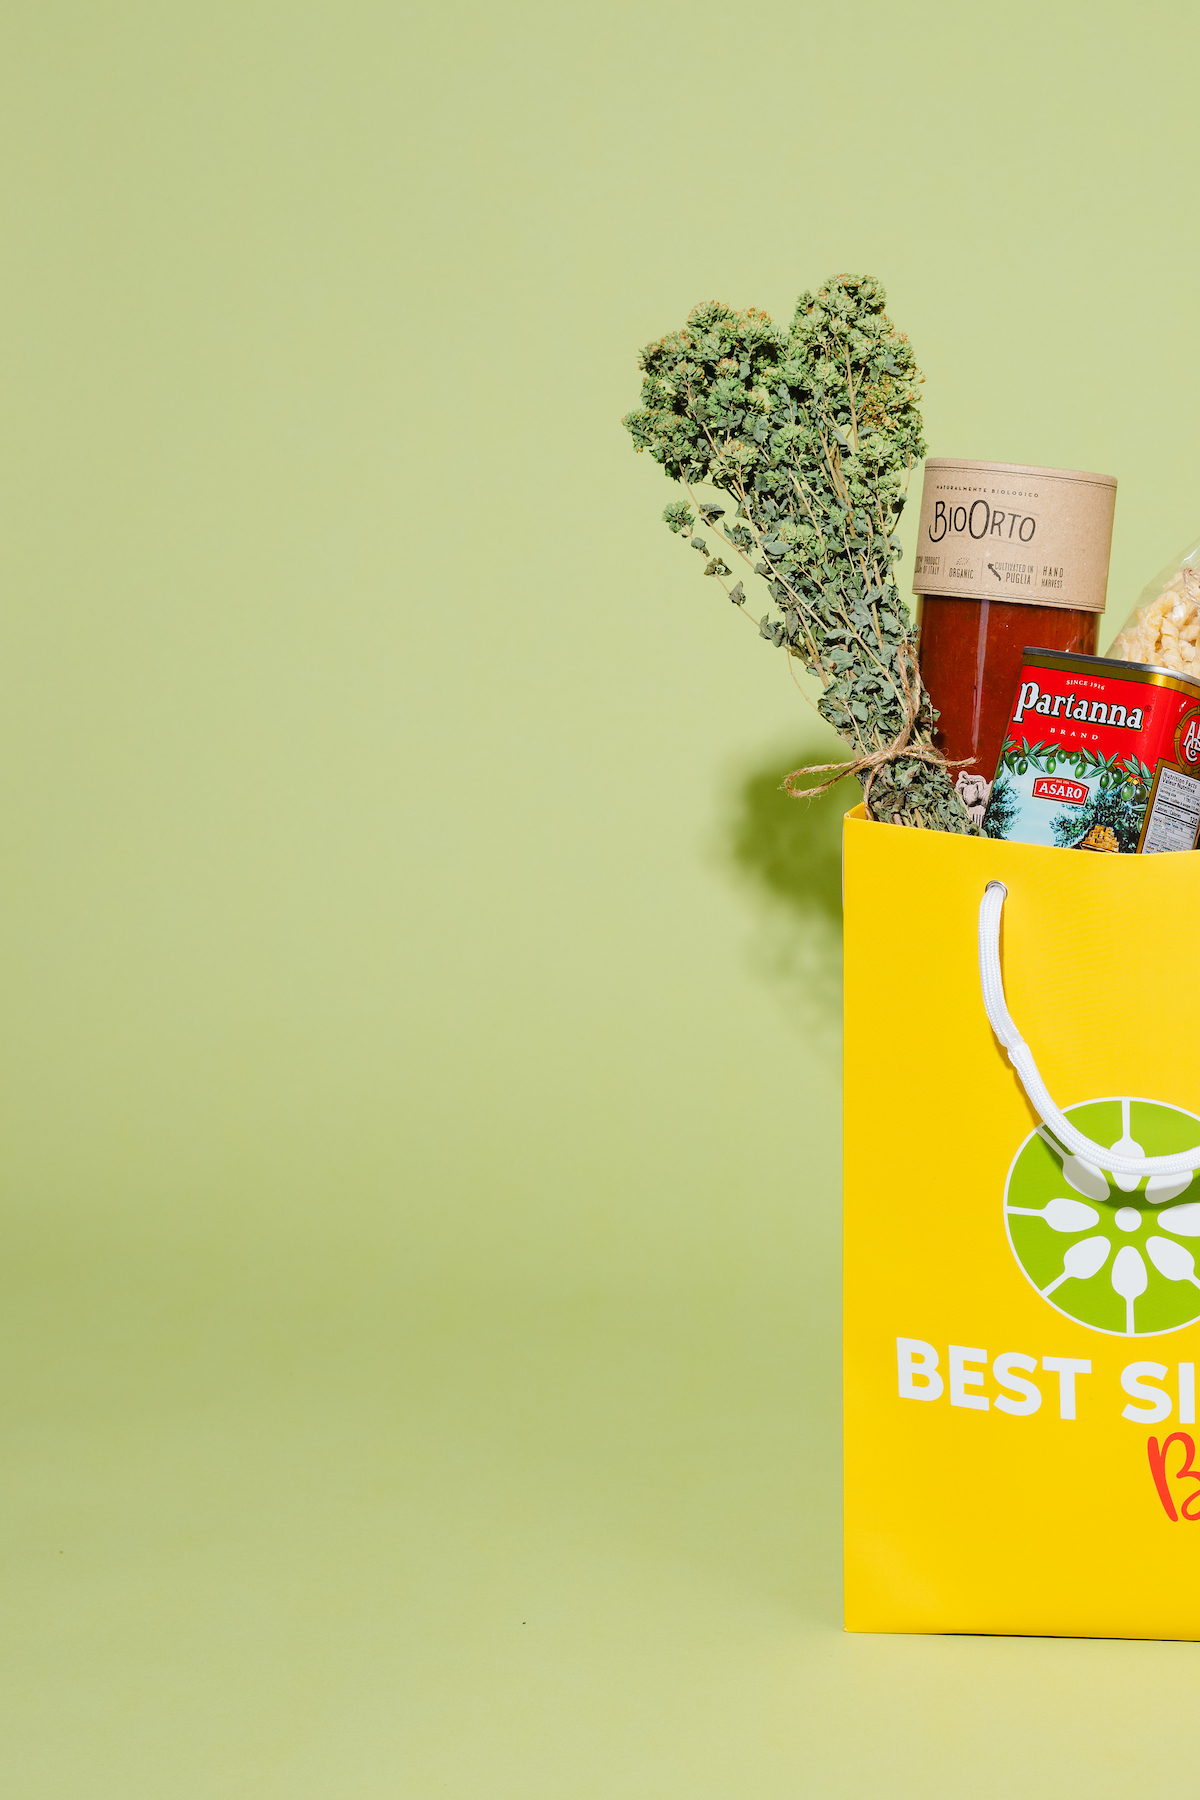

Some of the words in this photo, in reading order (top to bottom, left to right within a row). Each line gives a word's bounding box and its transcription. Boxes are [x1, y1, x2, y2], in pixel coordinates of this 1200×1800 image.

[936, 484, 988, 493] NATURALMENTE
[992, 488, 1039, 498] BIOLOGICO
[949, 567, 974, 580] ORGANIC
[995, 562, 1026, 573] CULTIVATED
[1027, 565, 1034, 574] IN
[1042, 566, 1064, 578] HAND
[1006, 572, 1031, 585] PUGLIA
[1041, 578, 1063, 589] HARVEST
[1066, 678, 1088, 687] SINCE
[1090, 682, 1105, 690] 1916
[1012, 681, 1144, 730] Partanna
[1050, 726, 1099, 740] BRAND
[1038, 782, 1082, 800] ASARO
[896, 1336, 1092, 1420] BEST
